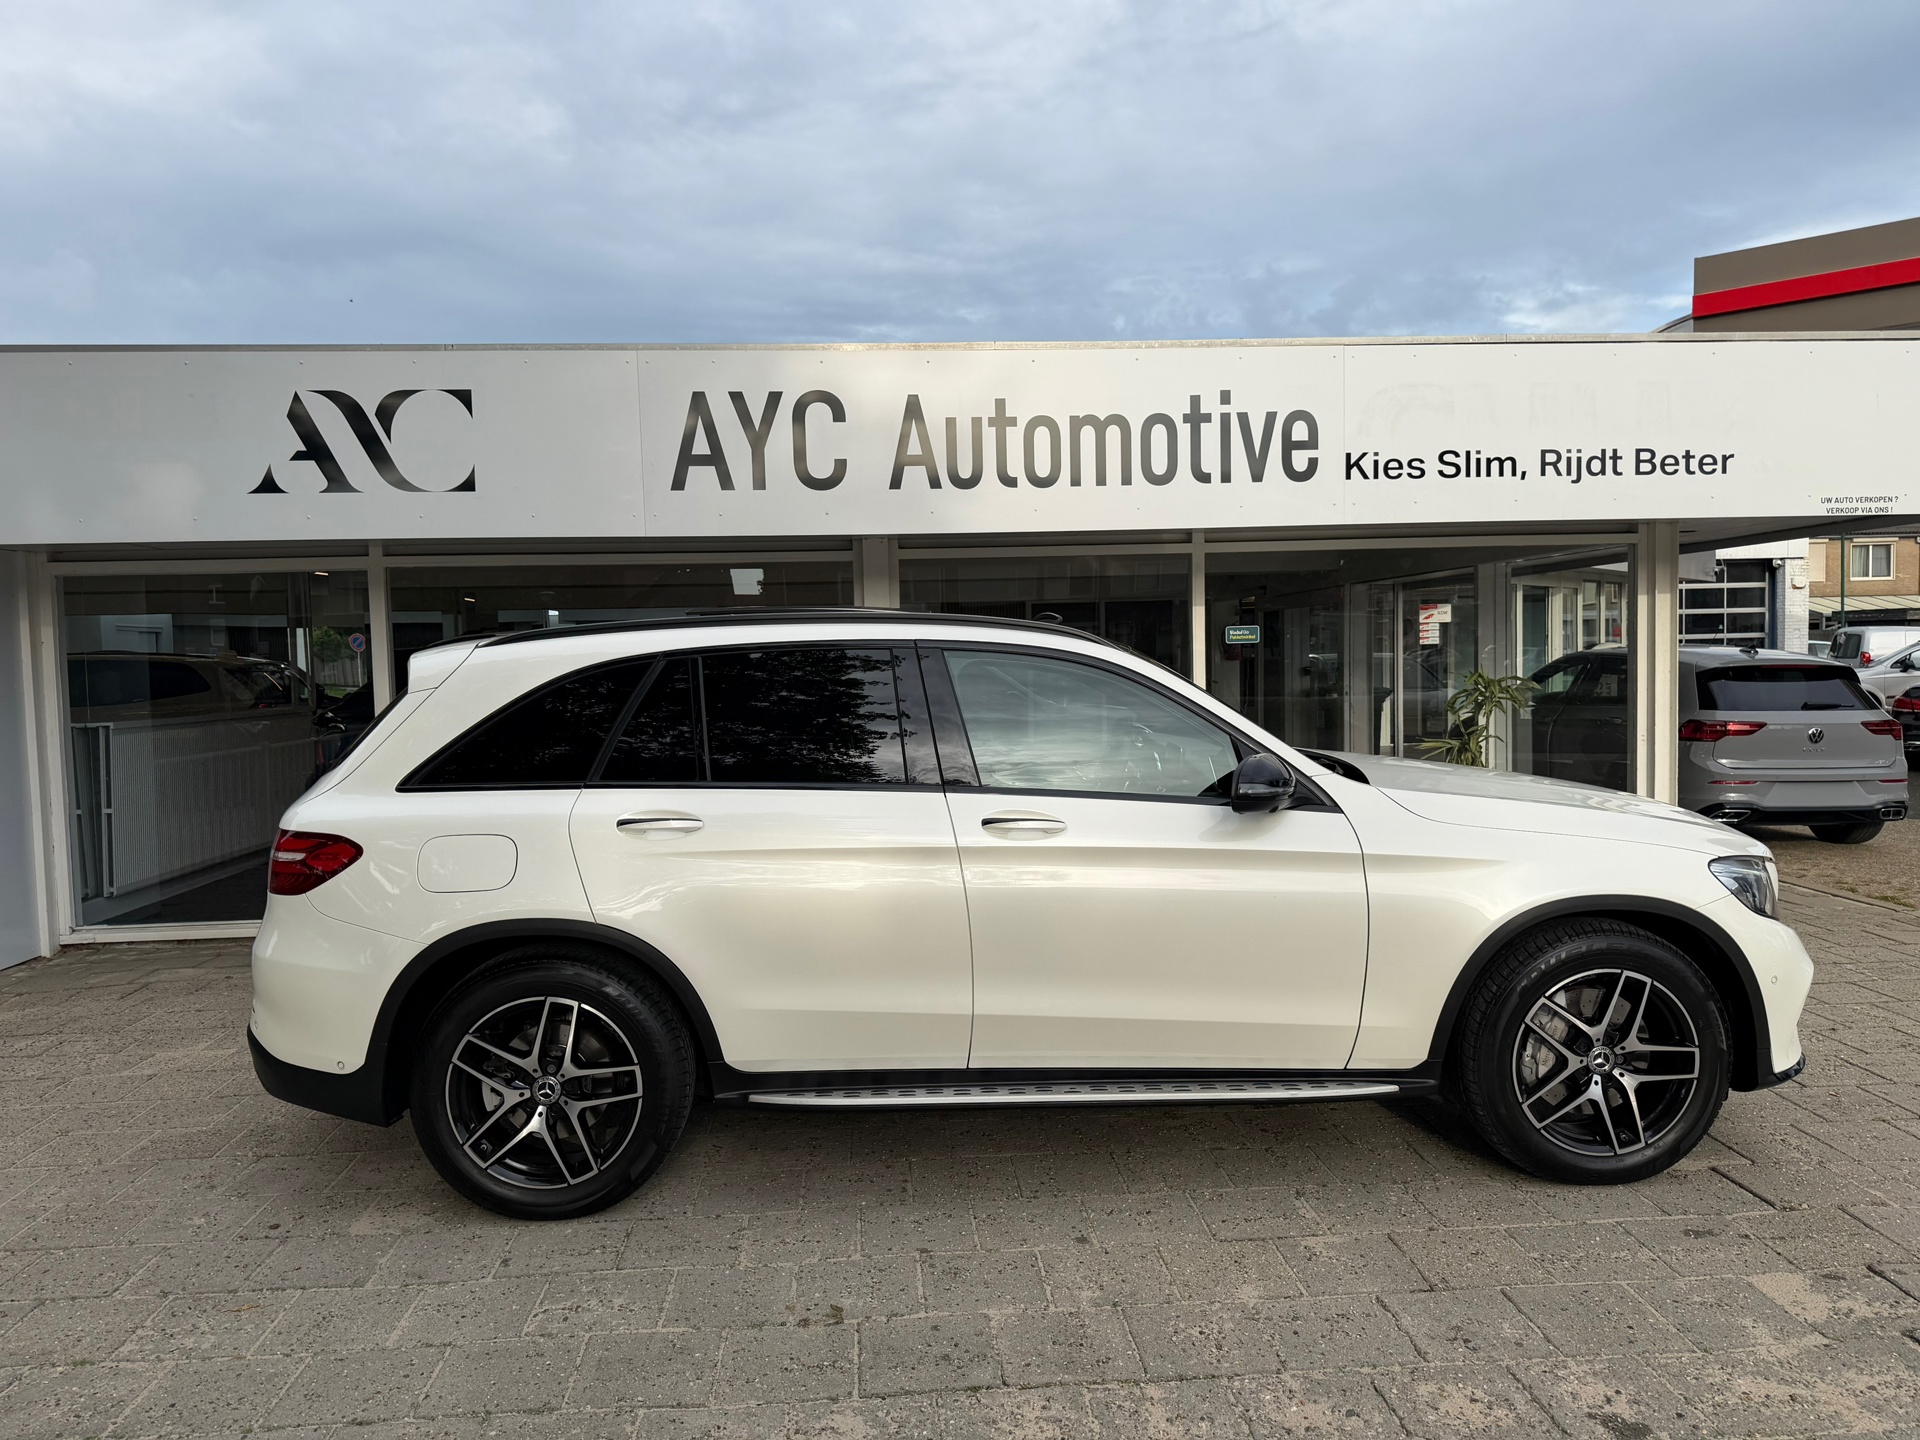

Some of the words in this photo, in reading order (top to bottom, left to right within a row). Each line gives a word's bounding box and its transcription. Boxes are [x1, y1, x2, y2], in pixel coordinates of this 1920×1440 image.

[669, 389, 848, 492] AYC
[888, 389, 1319, 491] Automotive
[1344, 451, 1427, 481] Kies
[1437, 449, 1528, 482] Slim,
[1539, 447, 1624, 485] Rijdt
[1634, 447, 1736, 477] Beter
[1825, 506, 1860, 514] VERKOOP
[1860, 506, 1873, 514] VIA
[1874, 506, 1889, 514] ONS
[1834, 496, 1854, 504] AUTO
[1855, 496, 1893, 504] VERKOPEN
